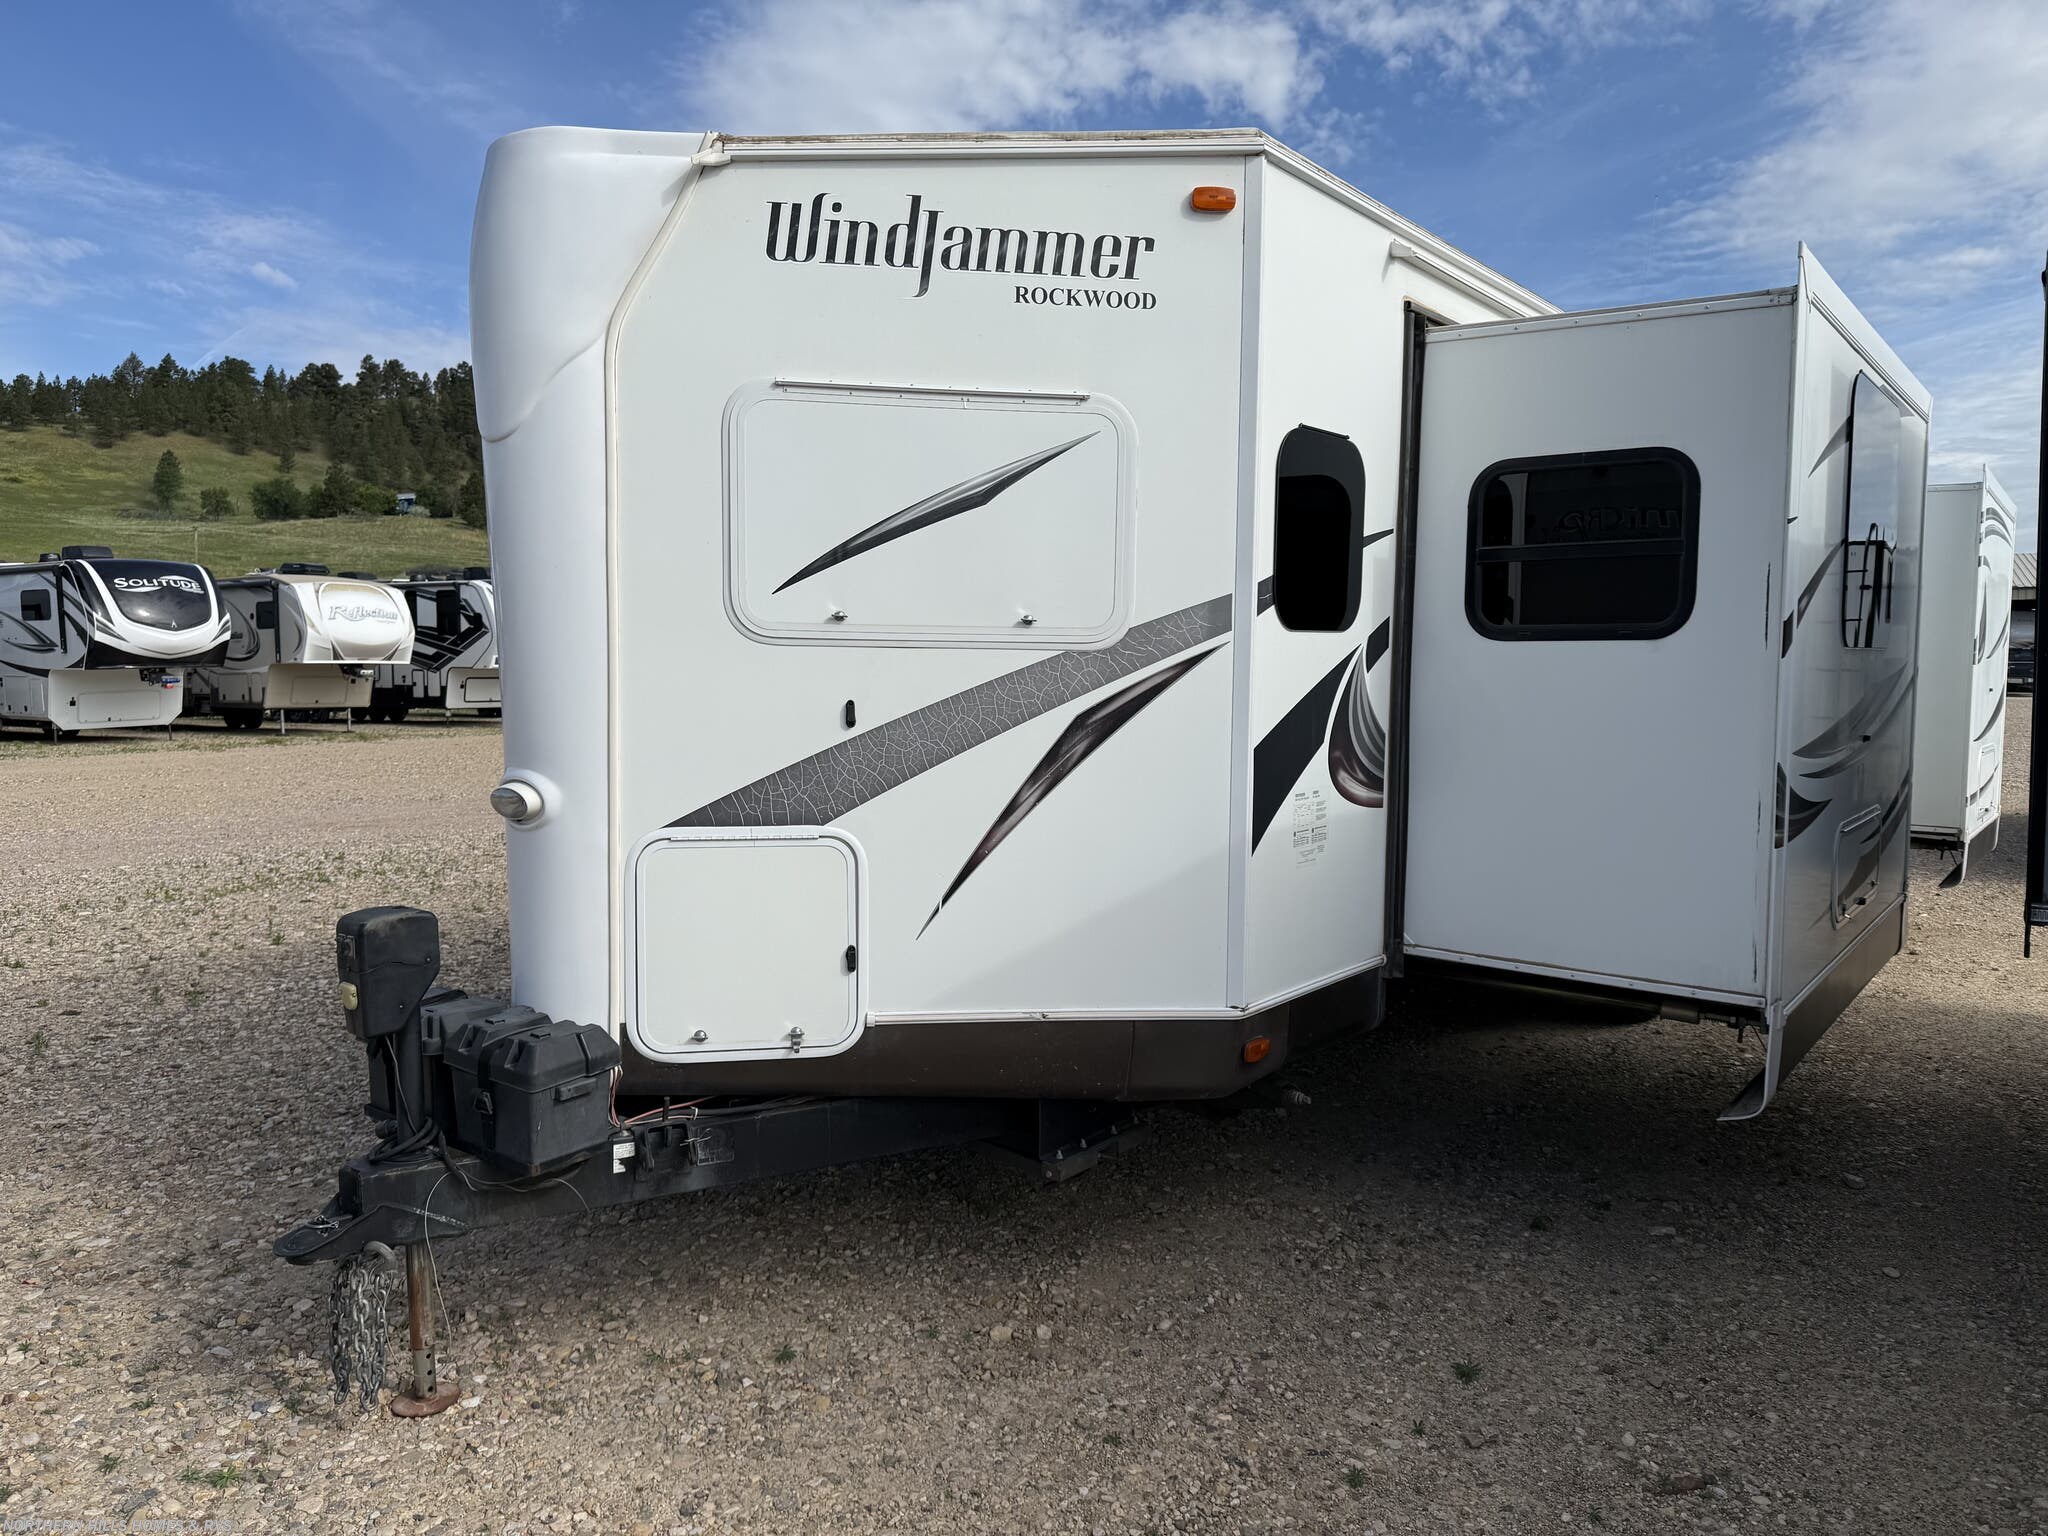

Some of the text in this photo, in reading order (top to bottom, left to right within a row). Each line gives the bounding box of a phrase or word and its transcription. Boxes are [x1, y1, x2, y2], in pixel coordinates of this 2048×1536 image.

[1014, 286, 1157, 310] ROCKWOOD
[114, 577, 202, 591] SOLITUDE
[328, 606, 398, 621] Reflection
